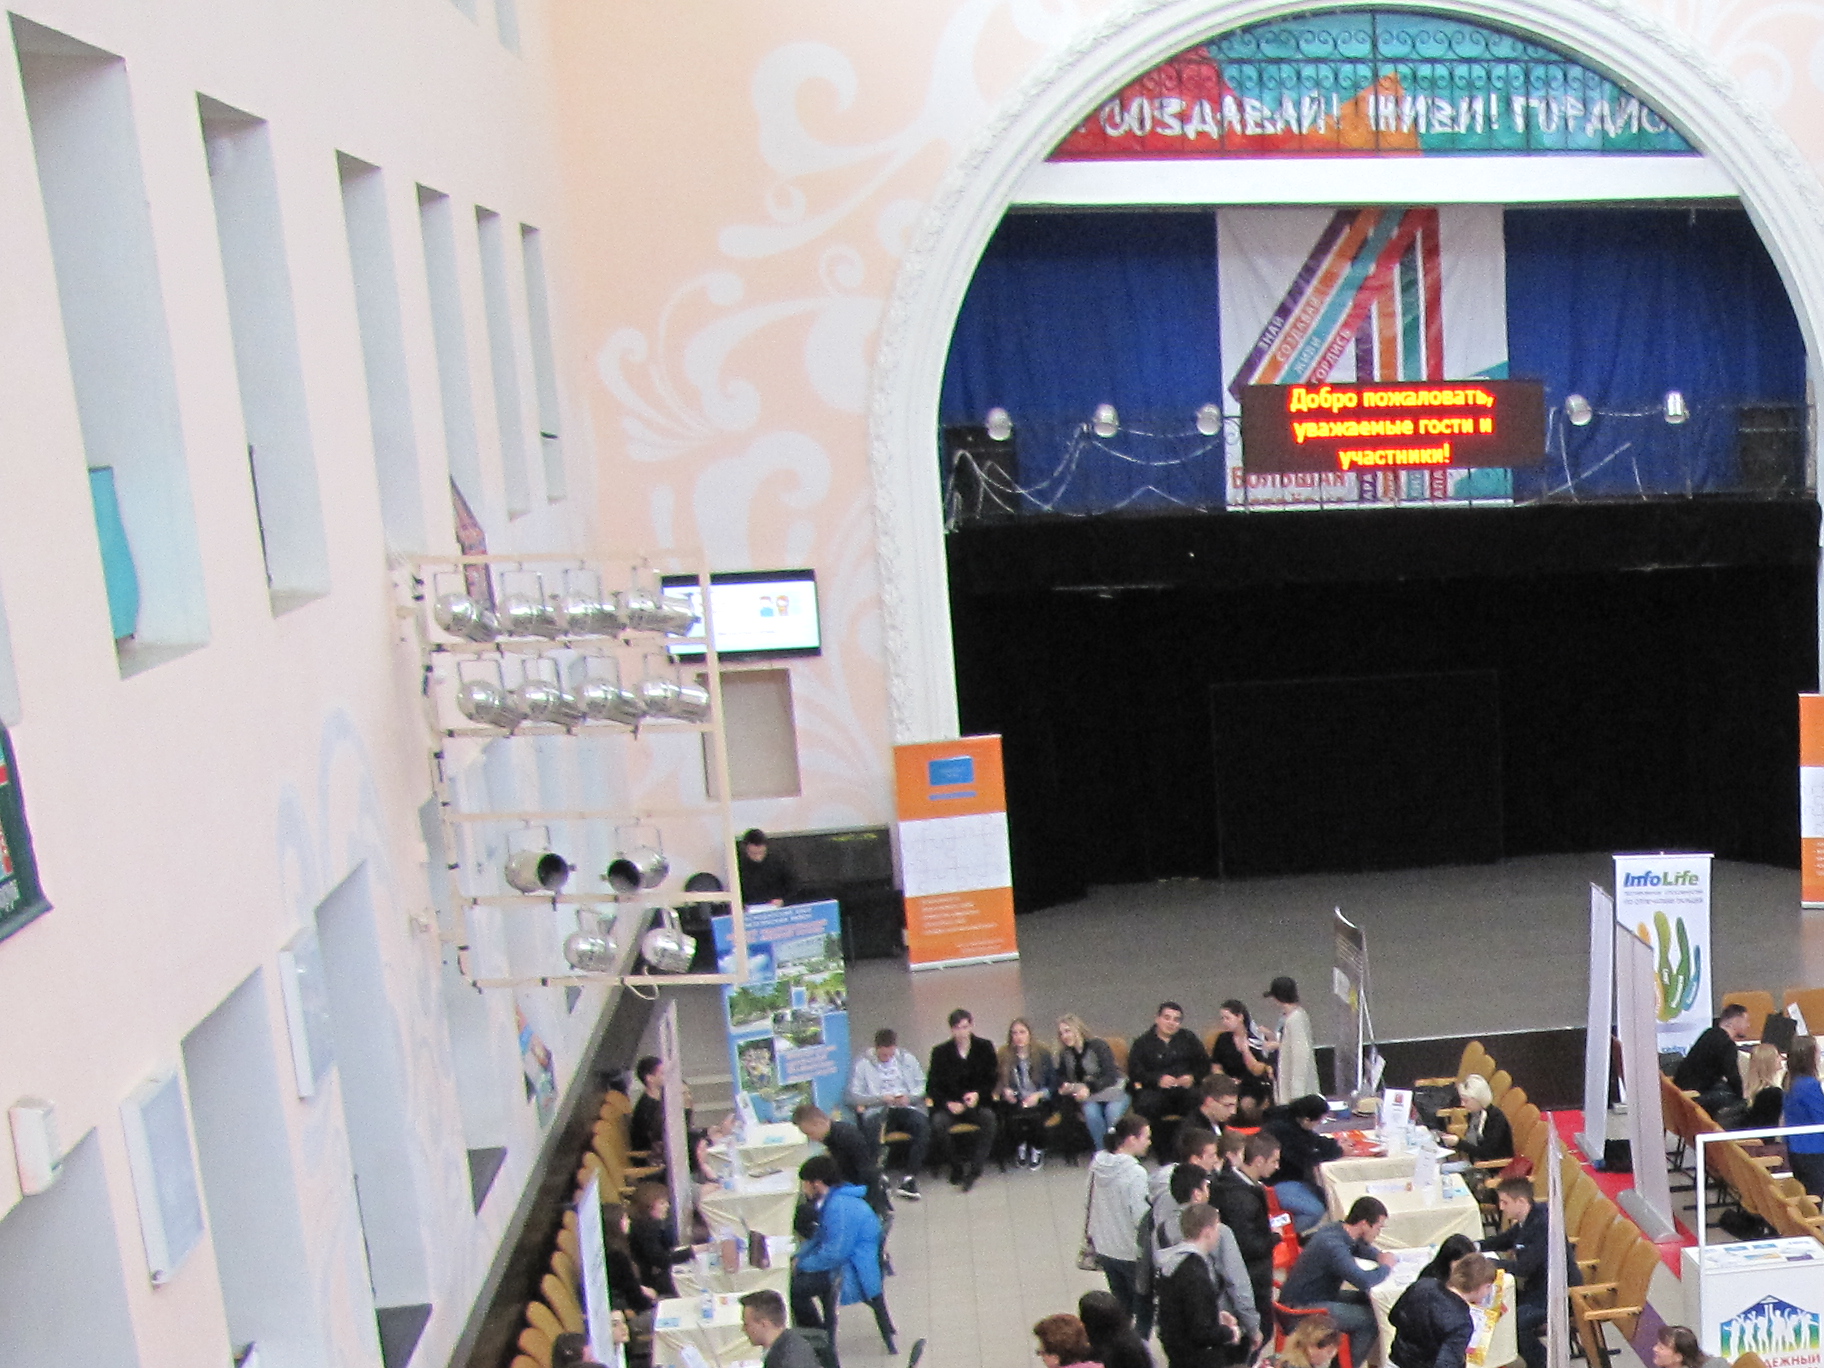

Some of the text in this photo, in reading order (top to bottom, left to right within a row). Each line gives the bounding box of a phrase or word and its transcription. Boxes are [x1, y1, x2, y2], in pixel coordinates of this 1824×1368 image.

[1367, 93, 1500, 135] ЖИВИ!
[1511, 94, 1671, 138] ГОРДИС
[1289, 386, 1496, 413] Добро пожаловать,
[1293, 417, 1493, 444] уважаемые гости и
[1338, 442, 1451, 471] участники!
